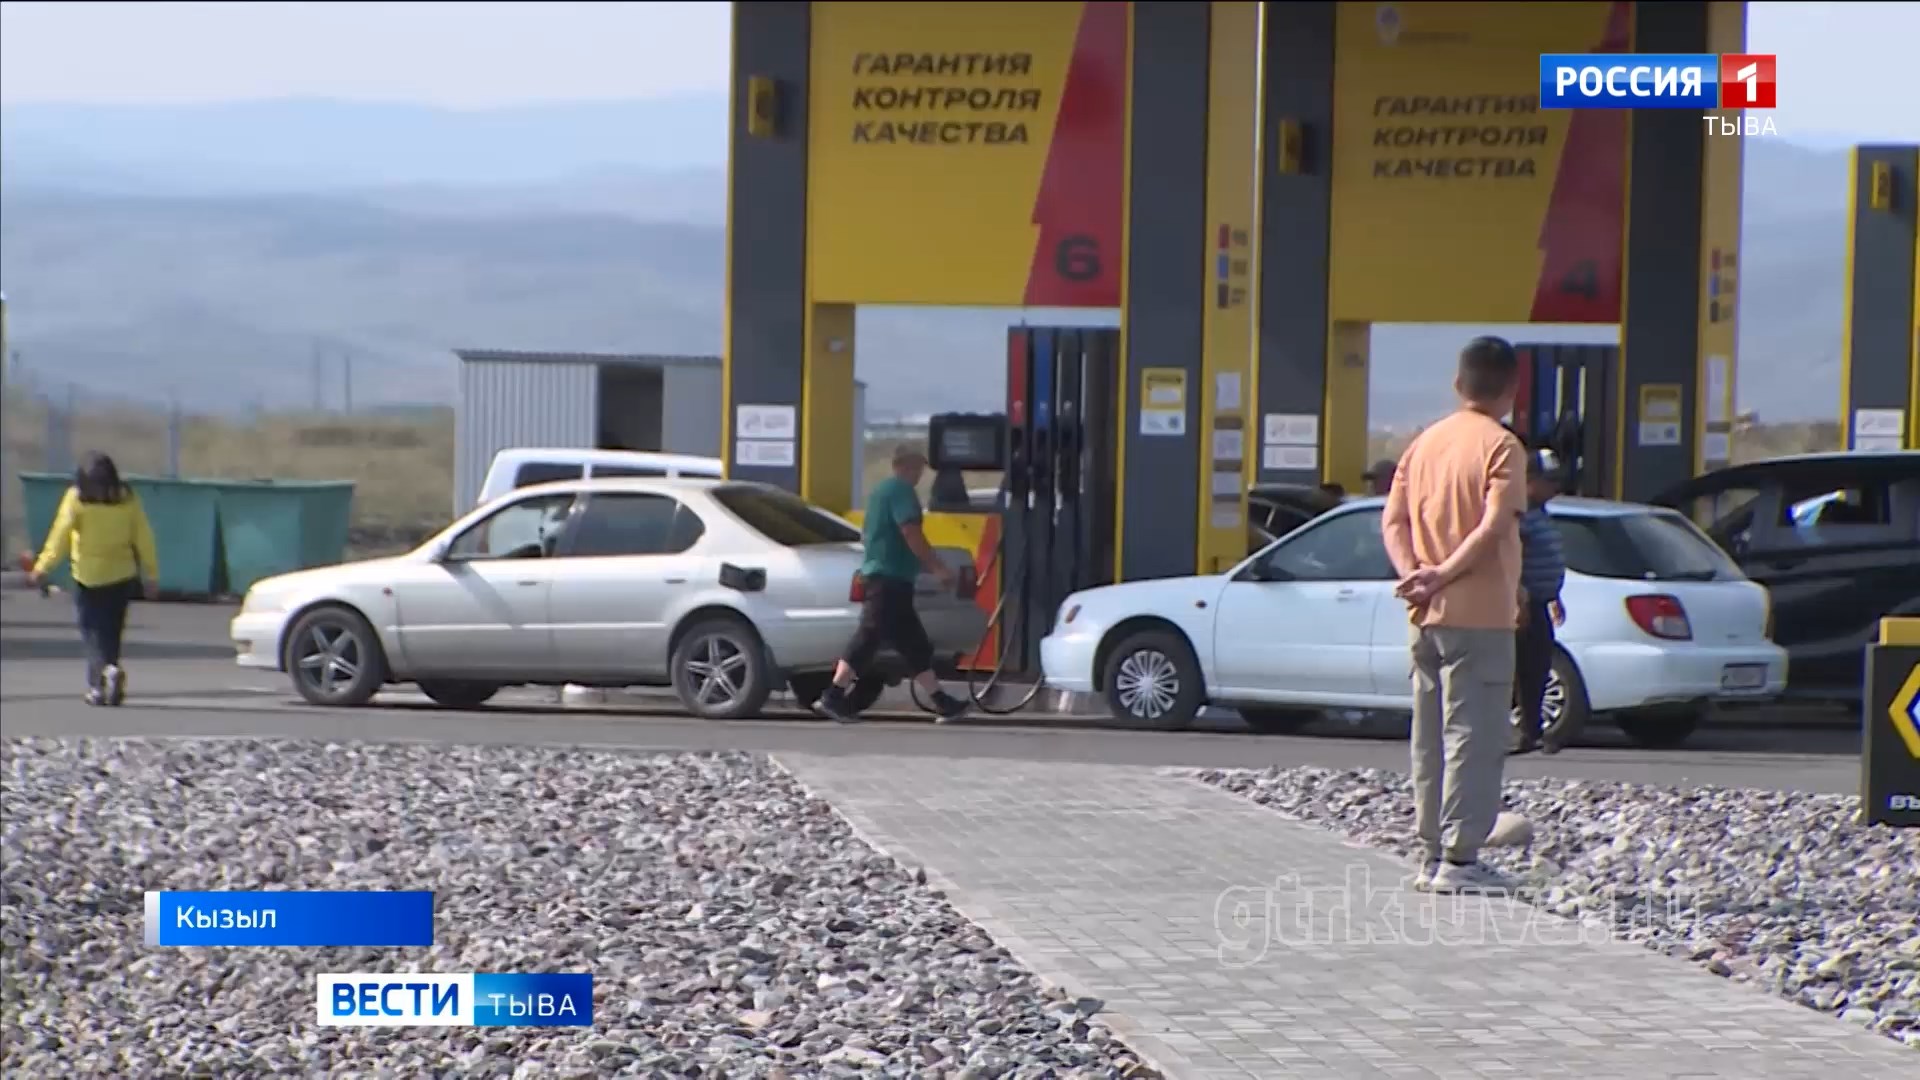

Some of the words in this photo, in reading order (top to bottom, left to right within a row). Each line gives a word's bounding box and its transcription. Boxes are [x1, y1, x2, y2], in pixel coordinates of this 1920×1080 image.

[853, 52, 1032, 76] ГАРАНТИЯ
[853, 87, 1041, 112] КОНТРОЛЯ
[1373, 95, 1539, 117] ГАРАНТИЯ
[853, 122, 1029, 145] КАЧЕСТВА
[1373, 126, 1549, 148] КОНТРОЛЯ
[1373, 158, 1537, 180] КАЧЕСТВА
[1055, 236, 1102, 282] 6
[1562, 261, 1600, 301] 4
